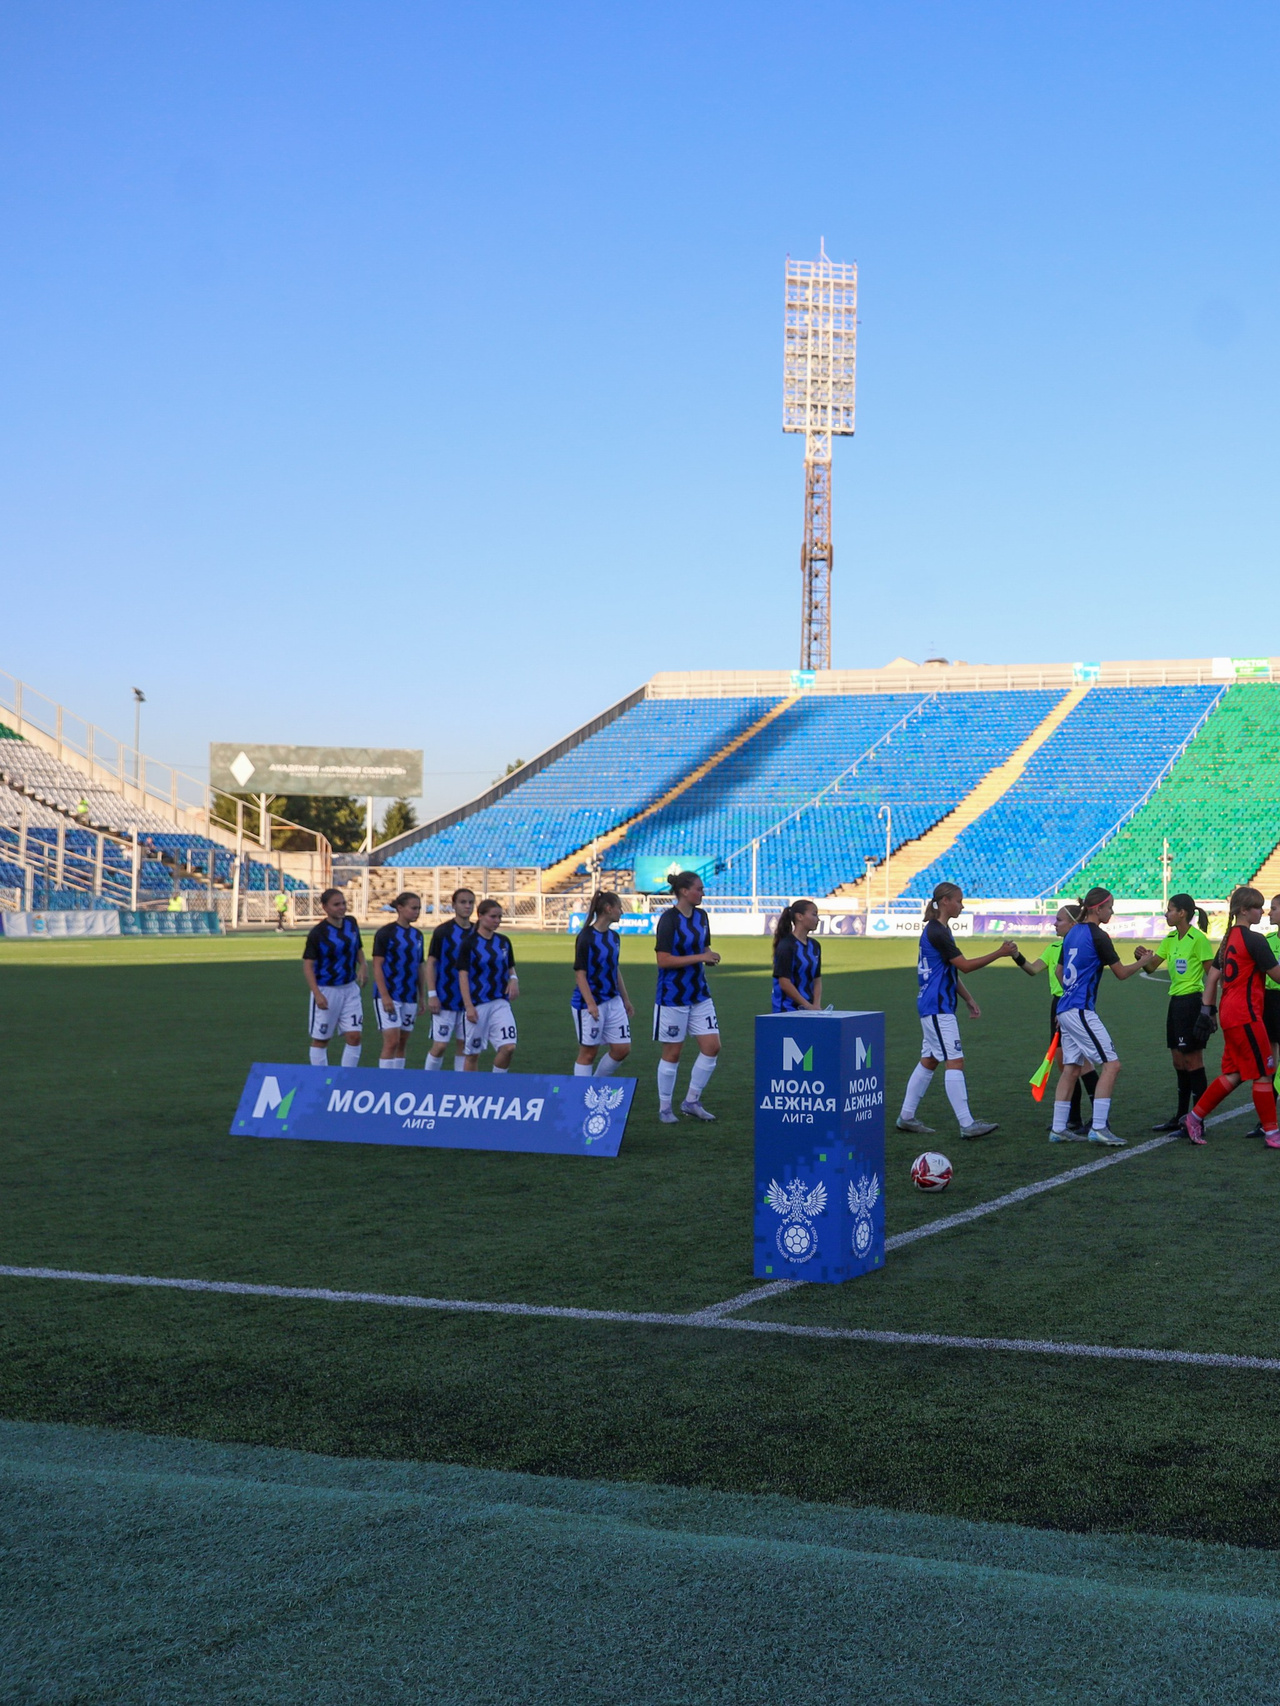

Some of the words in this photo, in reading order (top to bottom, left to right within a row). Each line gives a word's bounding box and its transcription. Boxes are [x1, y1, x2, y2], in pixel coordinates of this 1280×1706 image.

[1062, 947, 1078, 987] 3
[500, 1026, 516, 1040] 18
[770, 1079, 826, 1095] МОЛО
[849, 1075, 878, 1095] МОЛО
[327, 1089, 545, 1122] МОЛОДЕЖНАЯ
[760, 1096, 837, 1112] ДЕЖНАЯ
[843, 1090, 884, 1113] ДЕЖНАЯ
